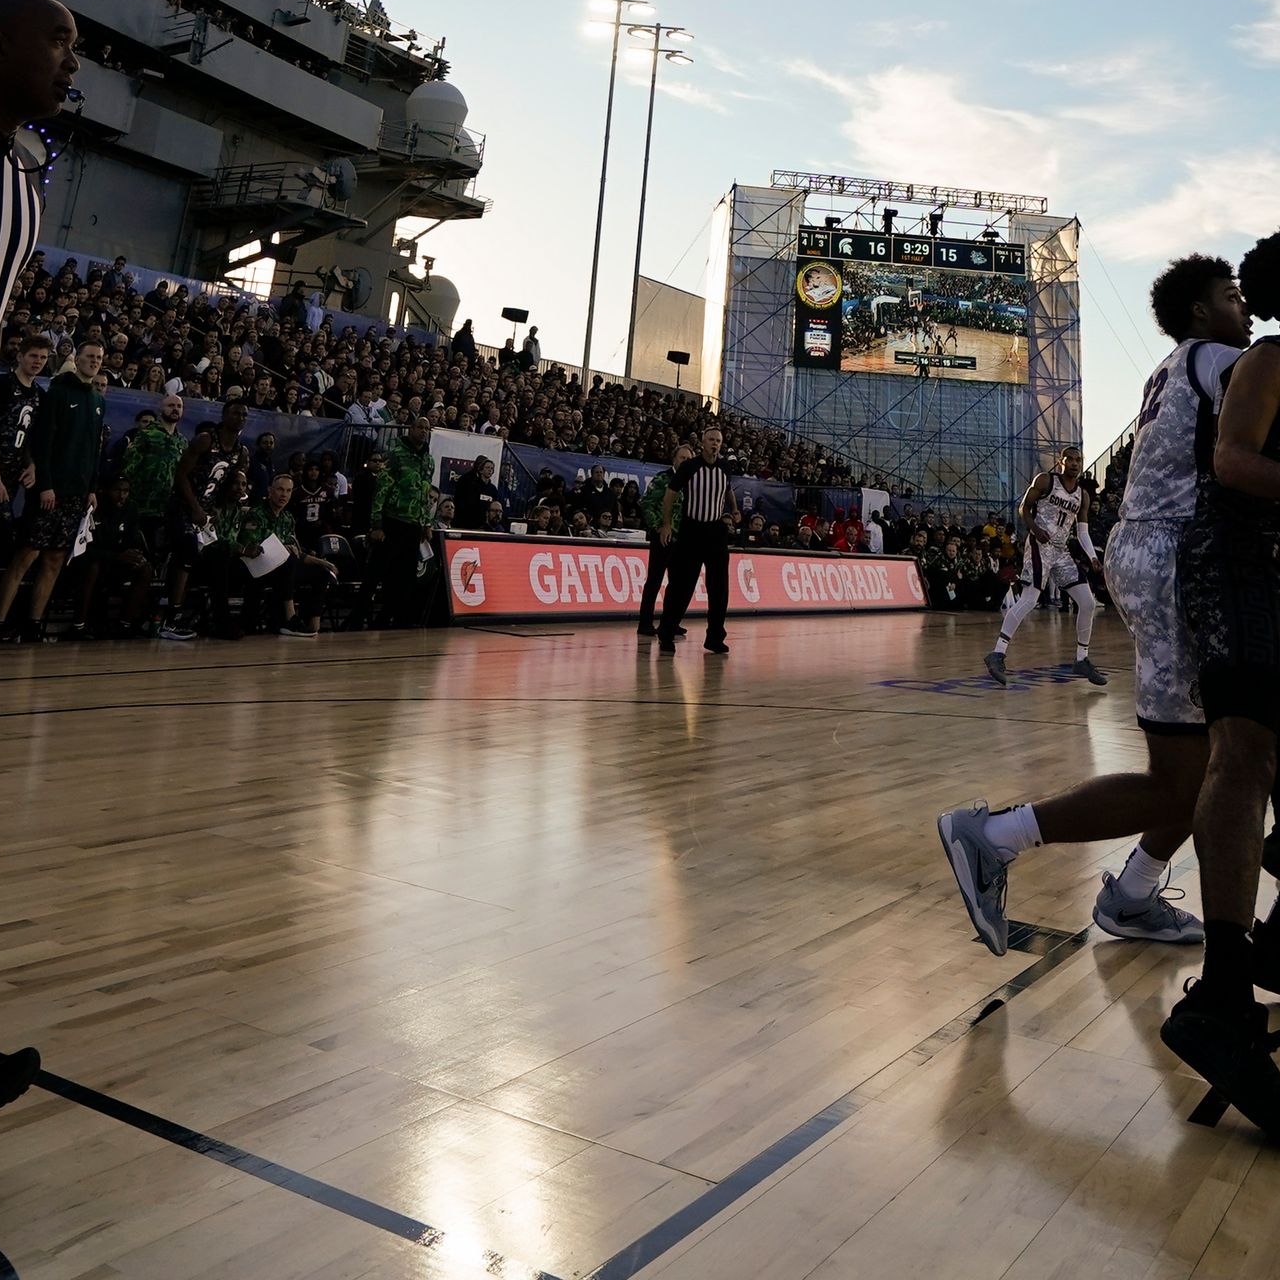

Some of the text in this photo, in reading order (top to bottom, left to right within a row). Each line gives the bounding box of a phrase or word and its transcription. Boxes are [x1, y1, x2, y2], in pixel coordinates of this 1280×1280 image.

[818, 239, 824, 247] 3
[868, 241, 886, 256] 16
[903, 242, 930, 256] 9:29
[940, 248, 958, 262] 15
[1000, 255, 1021, 265] 7 4
[14, 429, 26, 449] 0
[1057, 510, 1068, 527] 11
[450, 546, 486, 607] G
[738, 559, 761, 604] G
[781, 562, 894, 602] GATORADE
